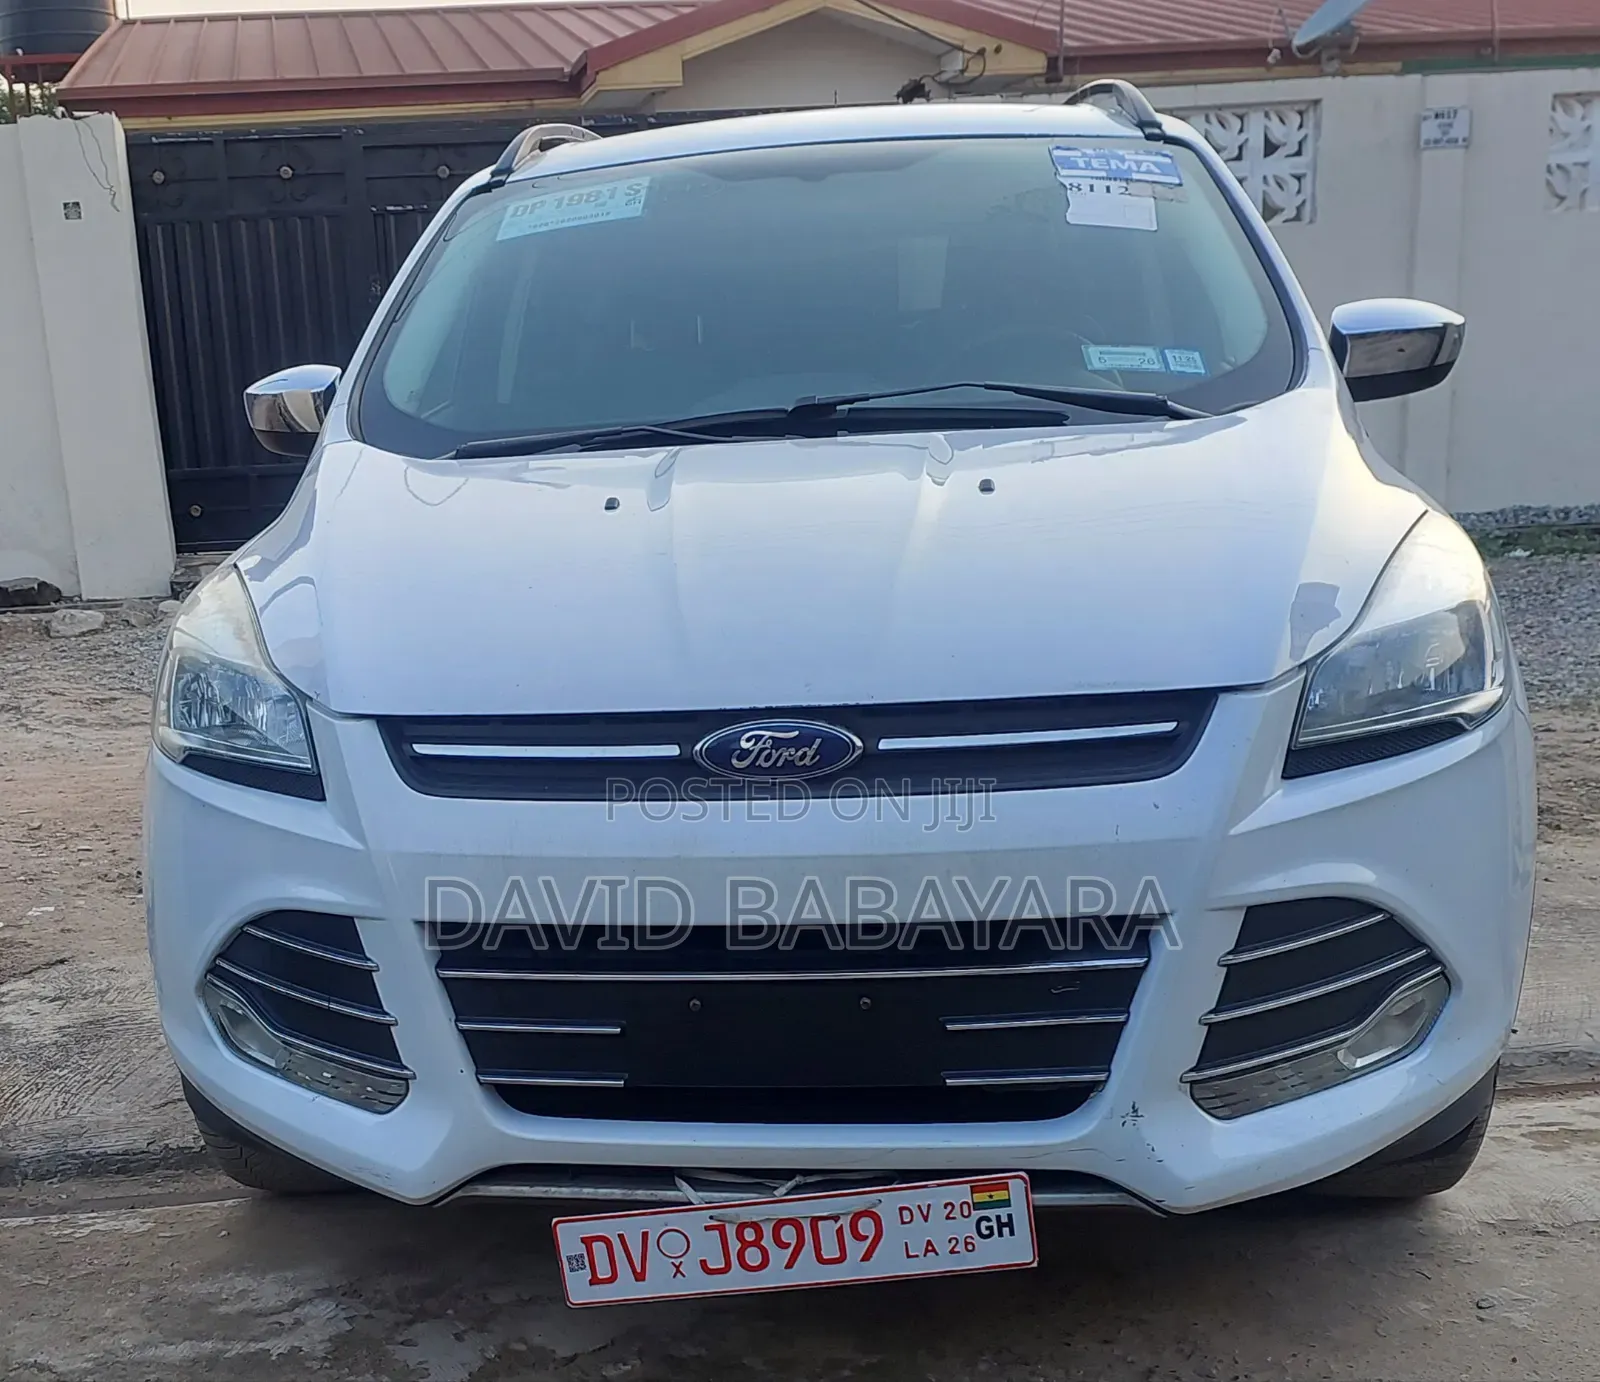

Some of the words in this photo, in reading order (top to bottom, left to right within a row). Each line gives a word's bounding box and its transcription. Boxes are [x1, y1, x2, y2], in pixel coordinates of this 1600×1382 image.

[1070, 157, 1162, 174] TEMA
[510, 202, 547, 219] DP
[554, 186, 617, 210] 1981
[625, 182, 643, 197] S
[731, 730, 822, 769] Ford
[898, 1203, 931, 1225] DV
[943, 1200, 972, 1220] 20
[975, 1213, 1015, 1240] GH
[580, 1230, 649, 1286] DV
[699, 1209, 884, 1276] J8909
[904, 1239, 939, 1259] LA
[948, 1235, 976, 1255] 26
